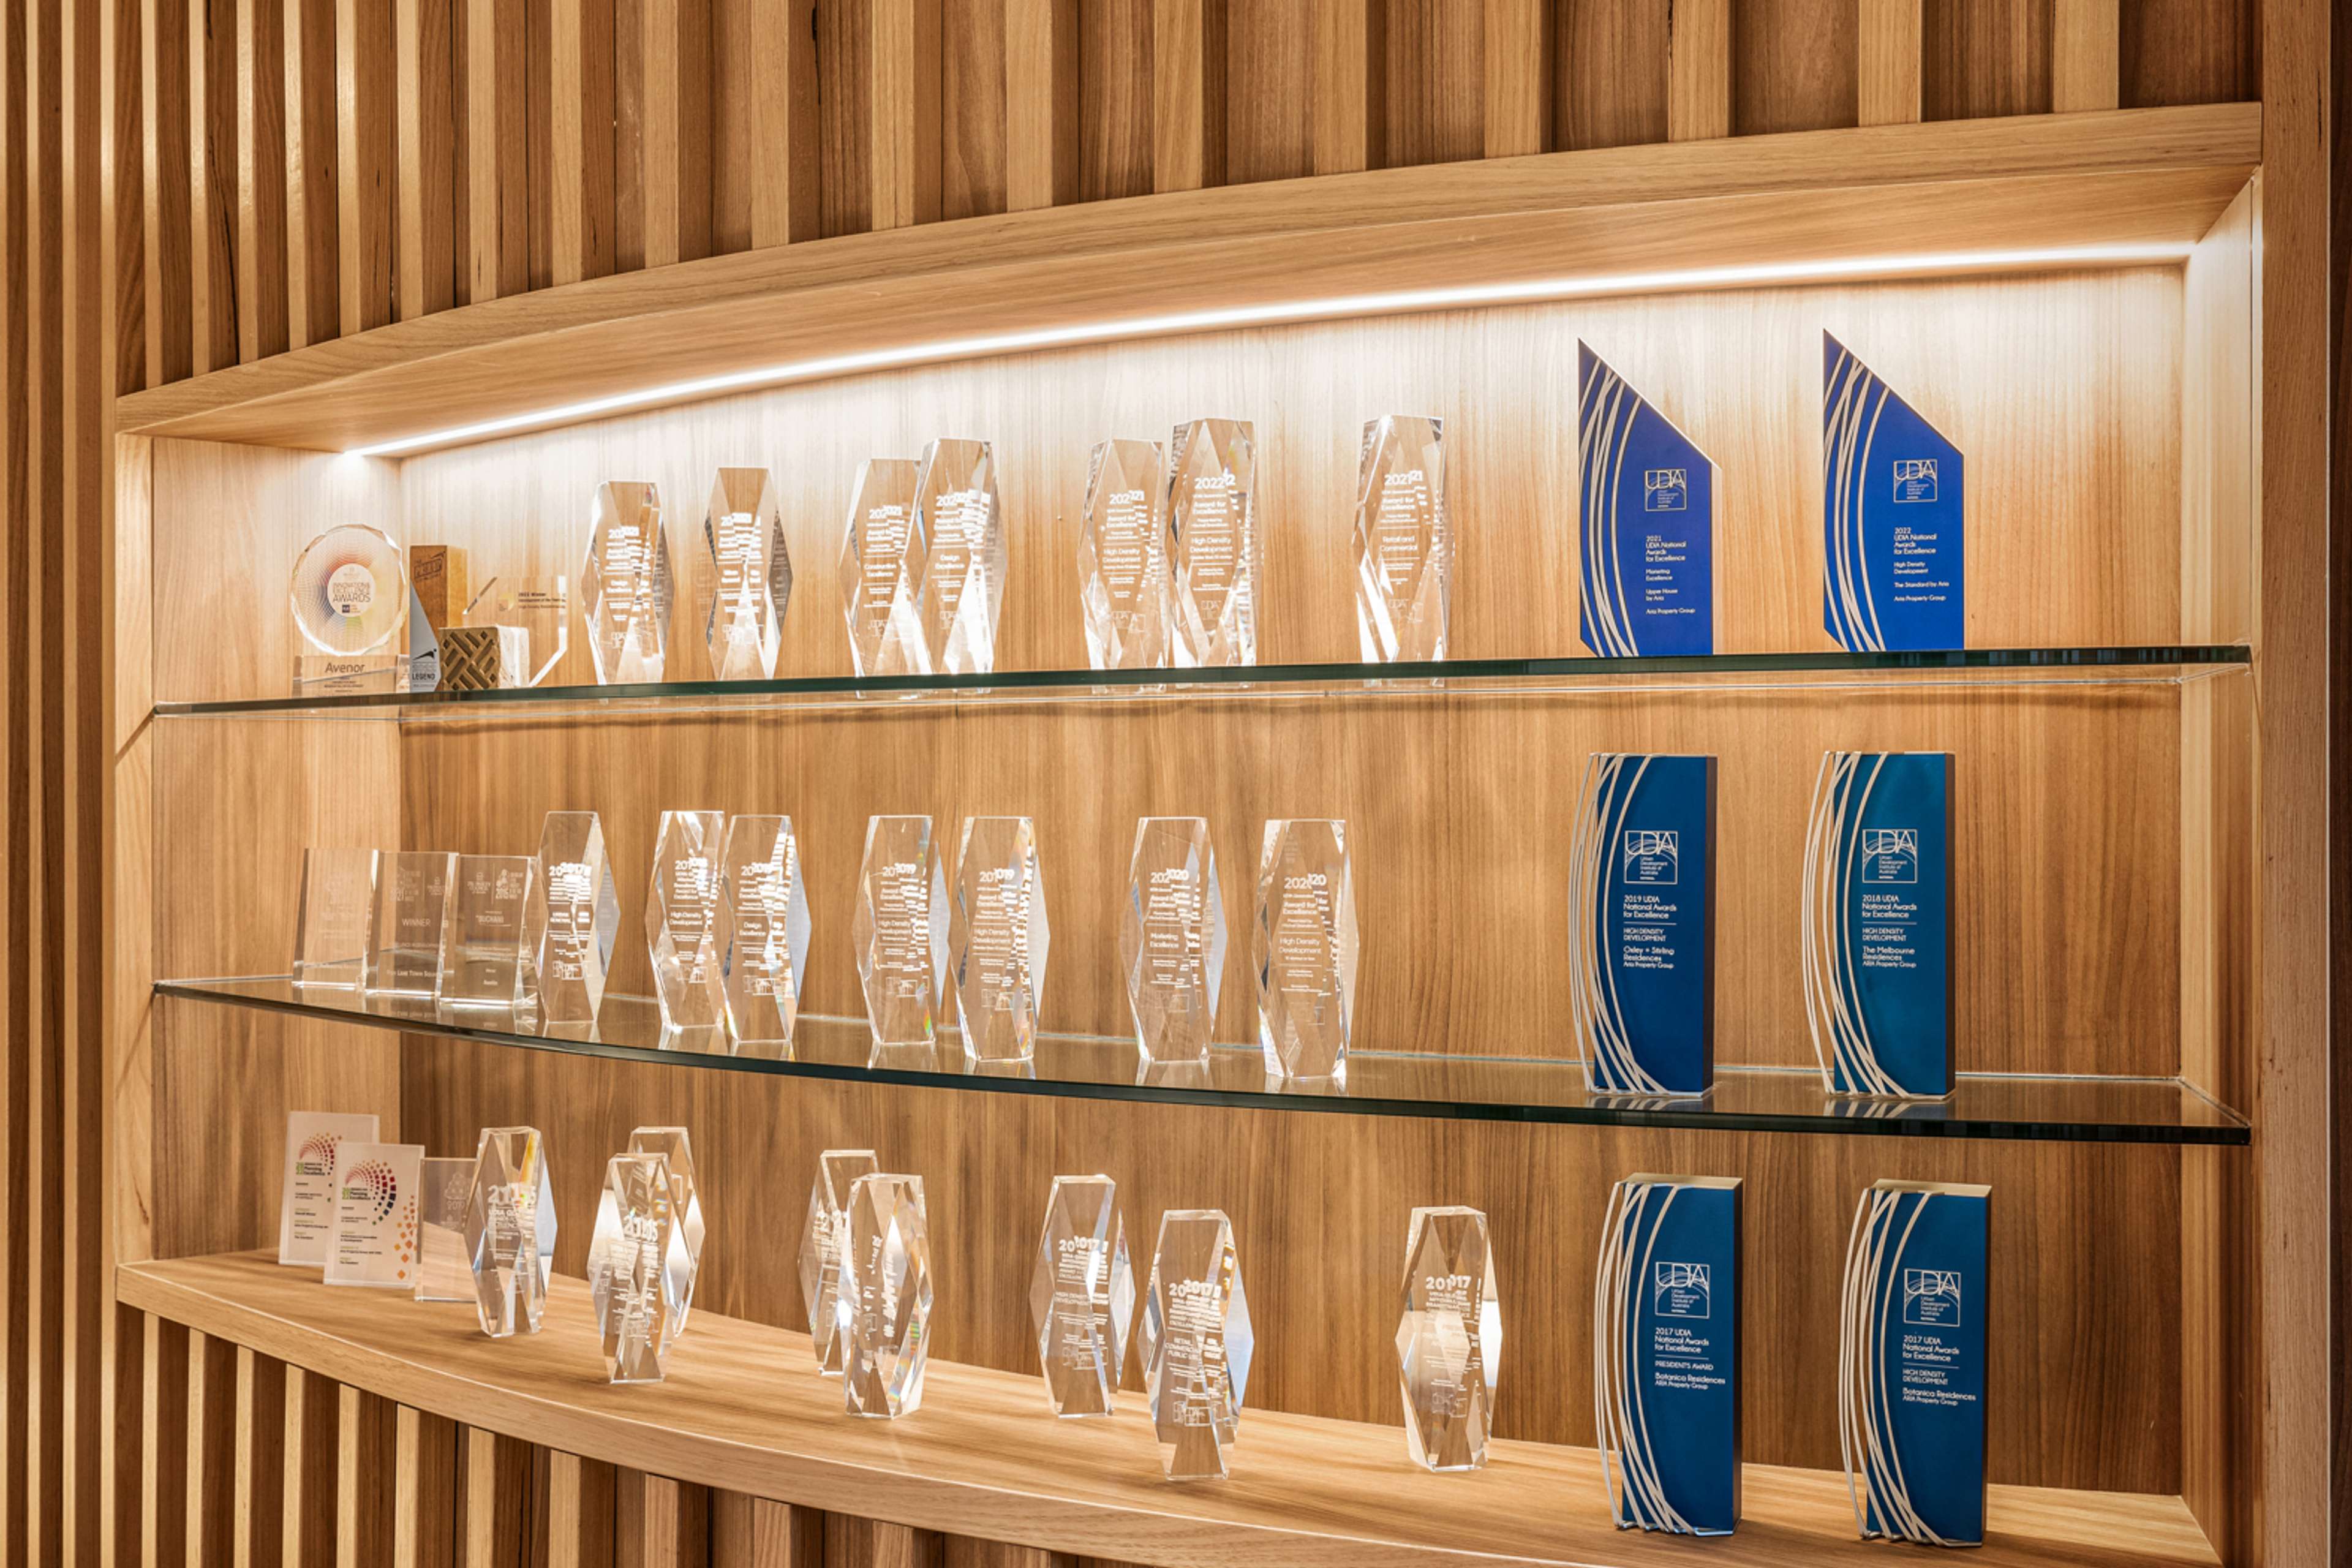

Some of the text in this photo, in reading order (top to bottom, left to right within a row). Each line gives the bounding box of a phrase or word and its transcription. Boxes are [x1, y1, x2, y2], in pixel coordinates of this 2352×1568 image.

[333, 593, 371, 603] AWARDS
[325, 662, 366, 673] Avenor
[1634, 911, 1669, 919] Excellence
[1863, 946, 1915, 955] The Melbourne
[1623, 953, 1662, 962] Residences
[1863, 953, 1902, 962] Residences
[1655, 1327, 1692, 1337] 2017 UDIA
[1655, 1335, 1709, 1346] National Awards
[1903, 1335, 1941, 1345] 2017 UDIA
[1665, 1344, 1702, 1354] Excellence
[1902, 1343, 1959, 1355] National Awards
[1913, 1352, 1951, 1362] Excellence
[1687, 1374, 1726, 1385] Residences
[1902, 1376, 1948, 1385] DEVELOPMENT
[1937, 1390, 1977, 1401] Residences
[1940, 1398, 1958, 1407] Group
